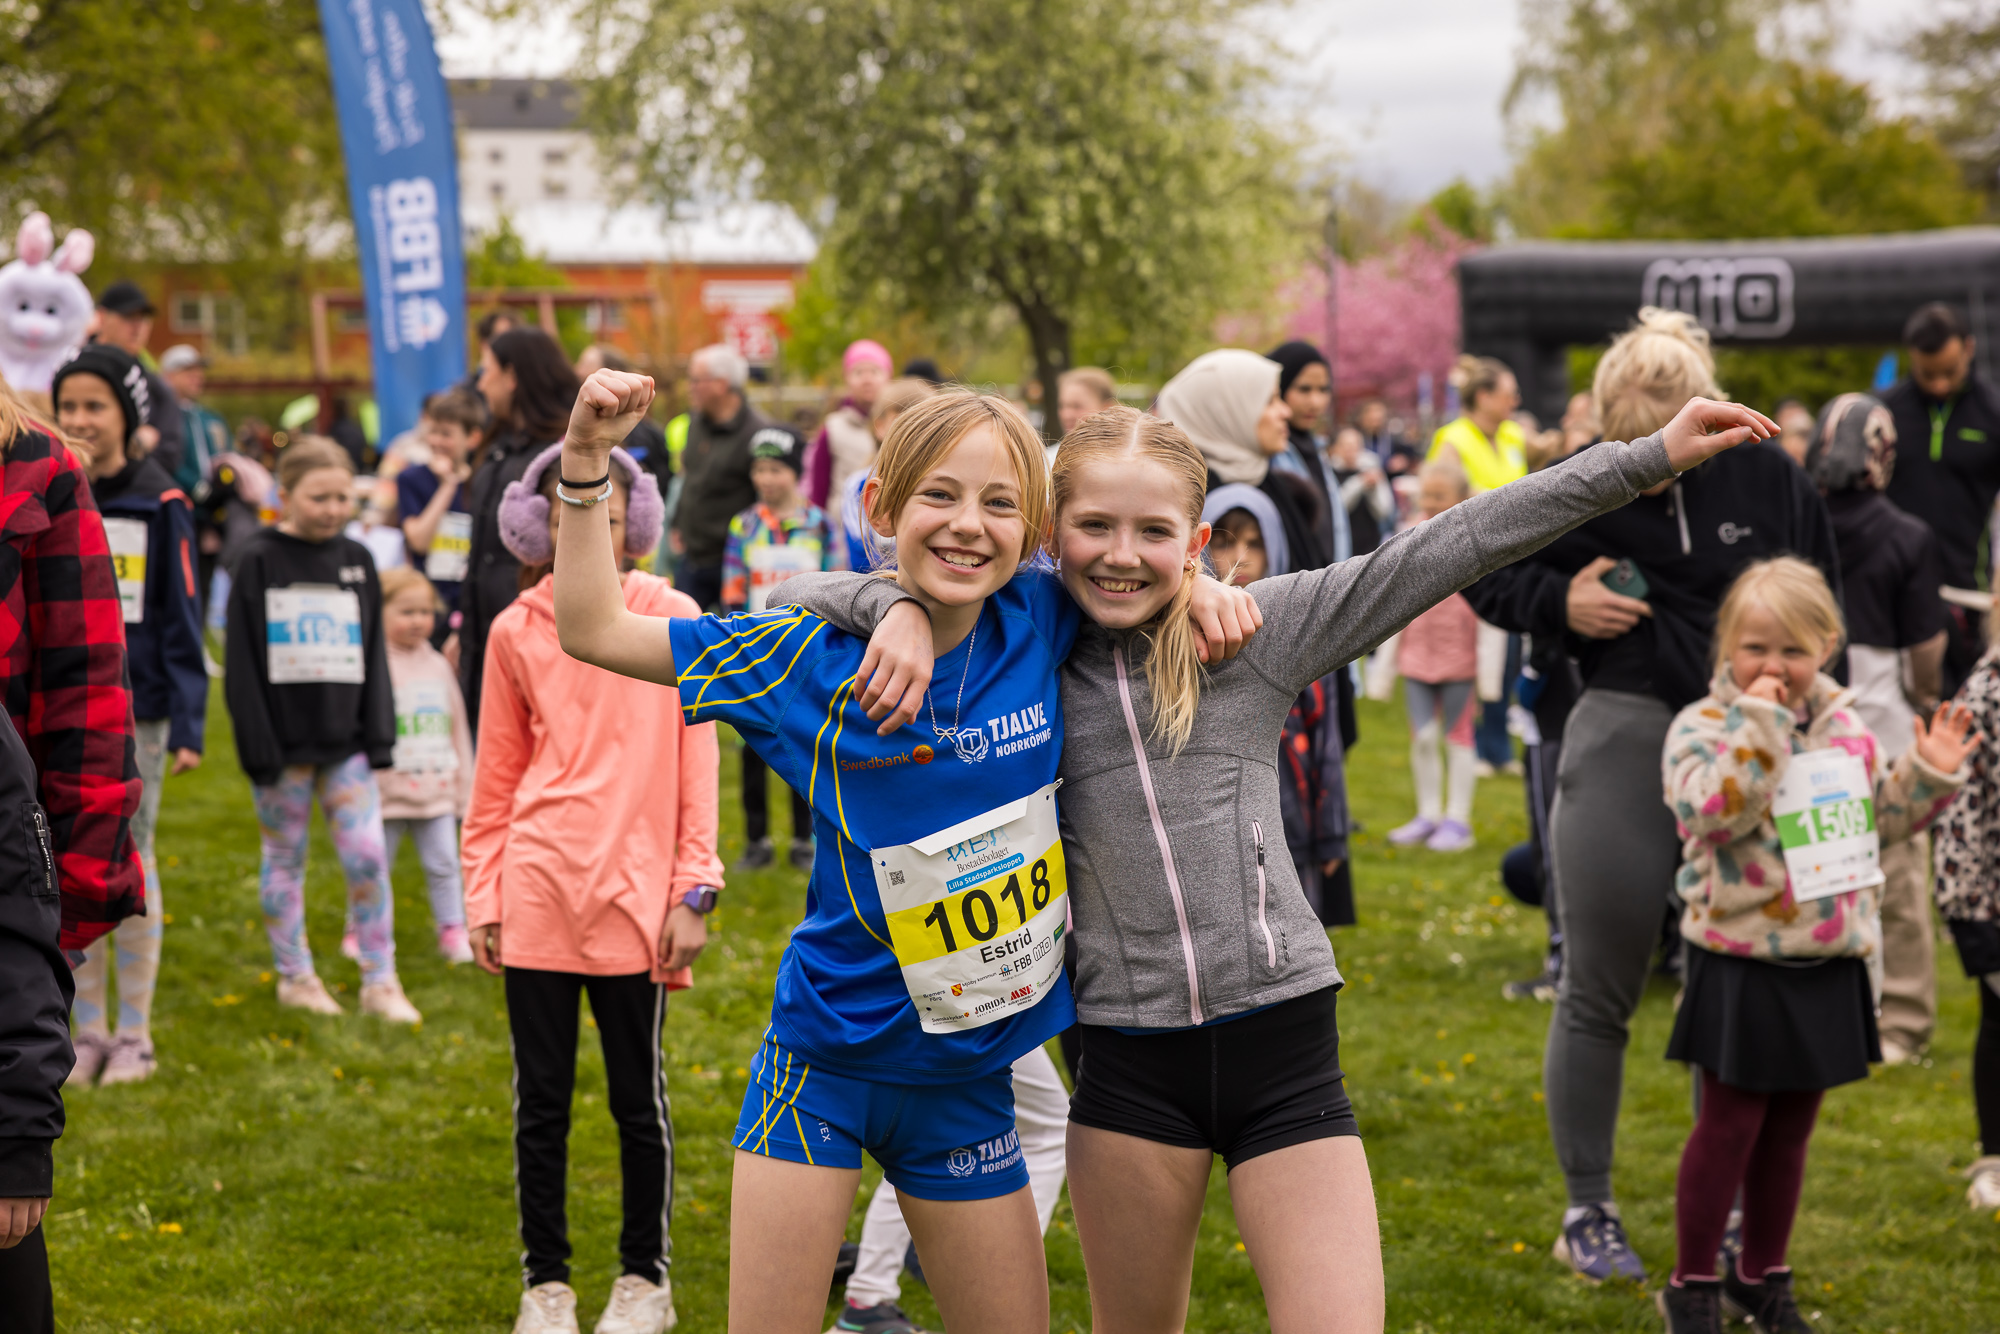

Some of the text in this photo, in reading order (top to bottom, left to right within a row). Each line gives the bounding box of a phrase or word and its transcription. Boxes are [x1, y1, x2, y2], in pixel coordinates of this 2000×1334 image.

[387, 176, 444, 292] FBB
[987, 701, 1048, 742] TJALVE
[995, 727, 1052, 758] NORRKÖPING
[840, 752, 911, 771] Swedbank
[1796, 799, 1868, 845] 1509
[948, 856, 1022, 890] Lilla Stadsparksloppet
[957, 847, 1009, 873] Bostadsbolaget
[924, 859, 1050, 953] 1018
[980, 927, 1032, 963] Estrid
[977, 972, 998, 982] kommun
[1013, 954, 1032, 973] FBB
[975, 997, 1006, 1015] JORIDA
[817, 1118, 831, 1142] TEX
[982, 1148, 1021, 1174] NORRKÖPIN
